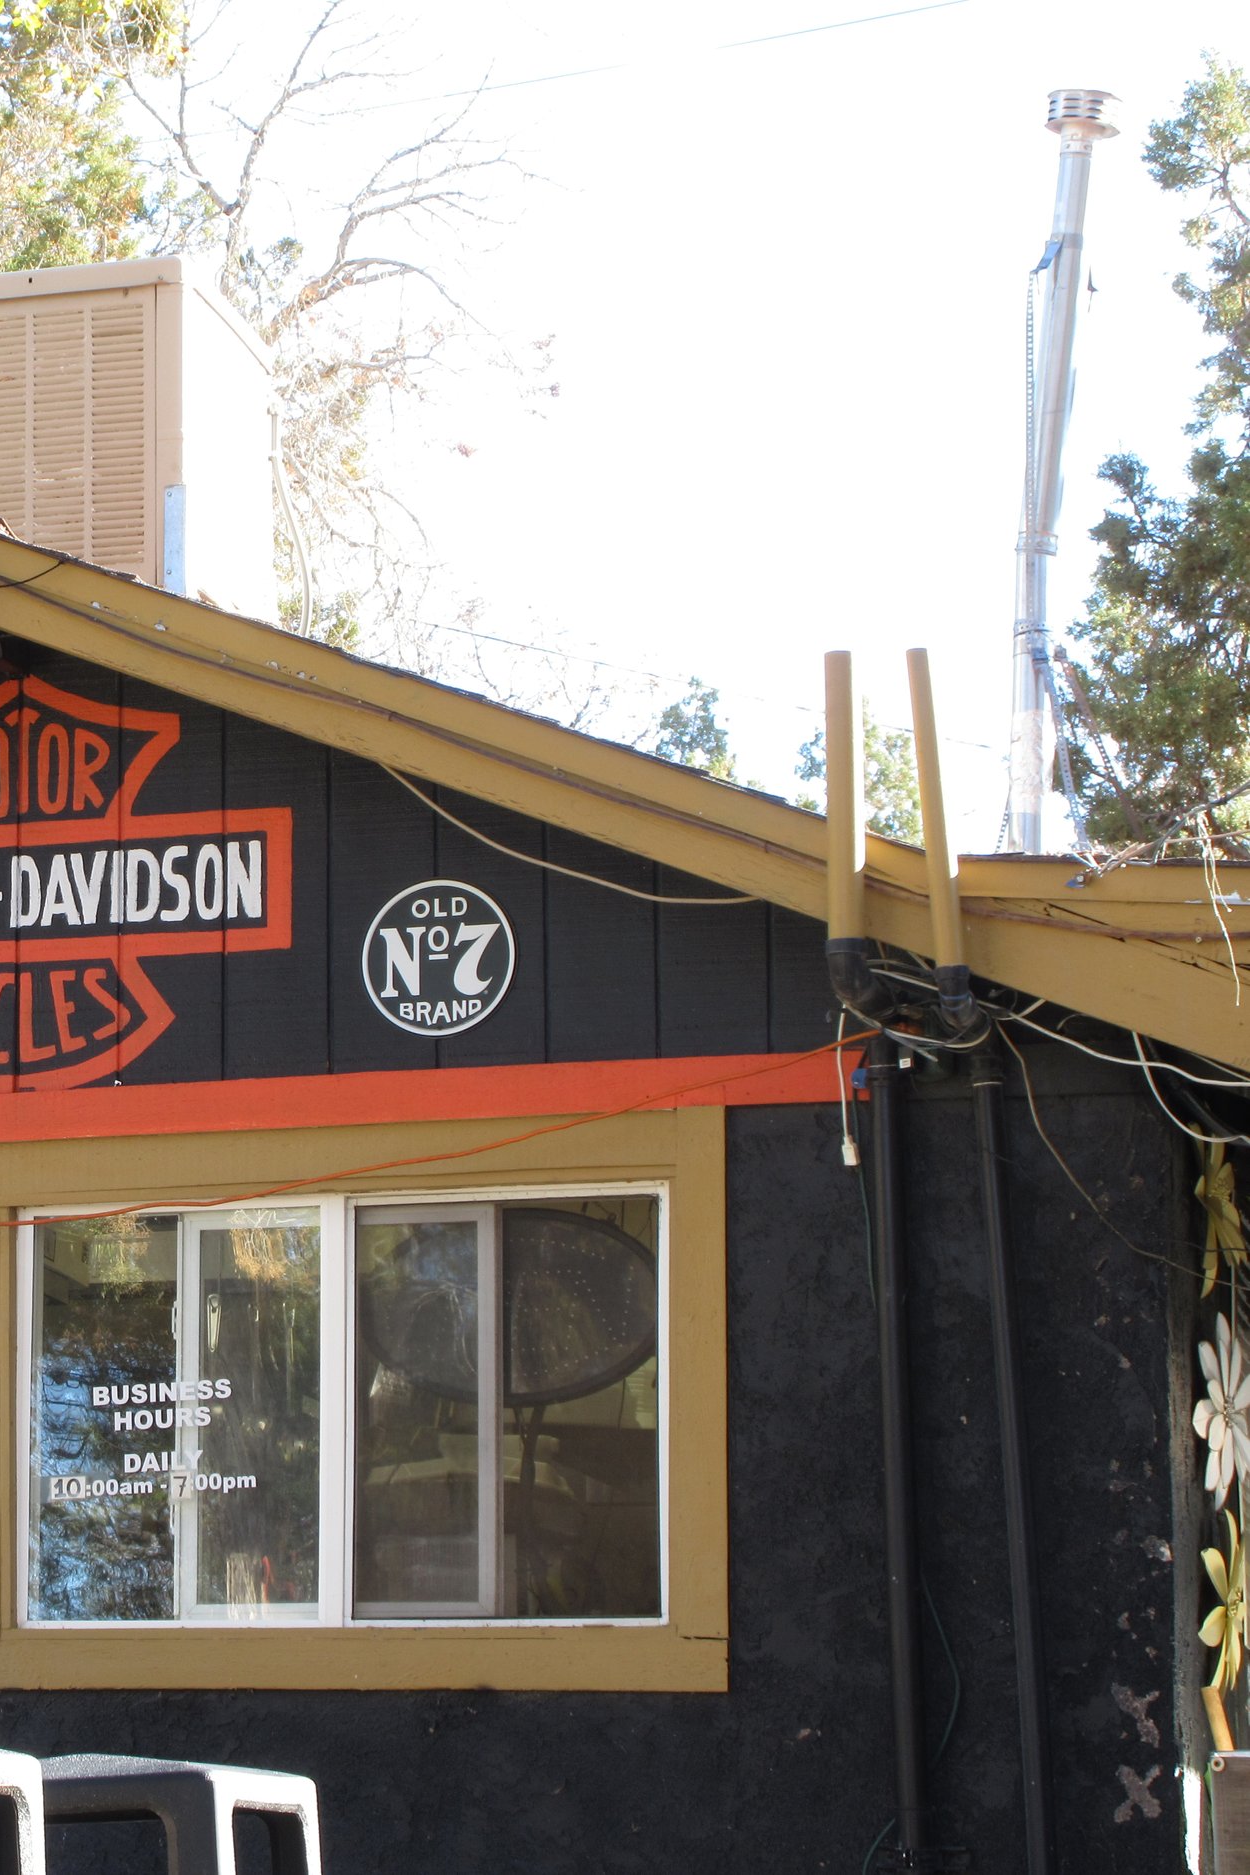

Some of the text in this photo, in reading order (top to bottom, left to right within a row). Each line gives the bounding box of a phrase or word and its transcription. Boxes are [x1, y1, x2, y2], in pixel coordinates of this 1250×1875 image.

[411, 896, 468, 919] OLD
[399, 999, 482, 1026] BRAND
[92, 1378, 232, 1406] BUSINESS
[113, 1406, 211, 1432] HOURS
[123, 1449, 204, 1473] DAILY
[52, 1477, 153, 1498] 10:00am
